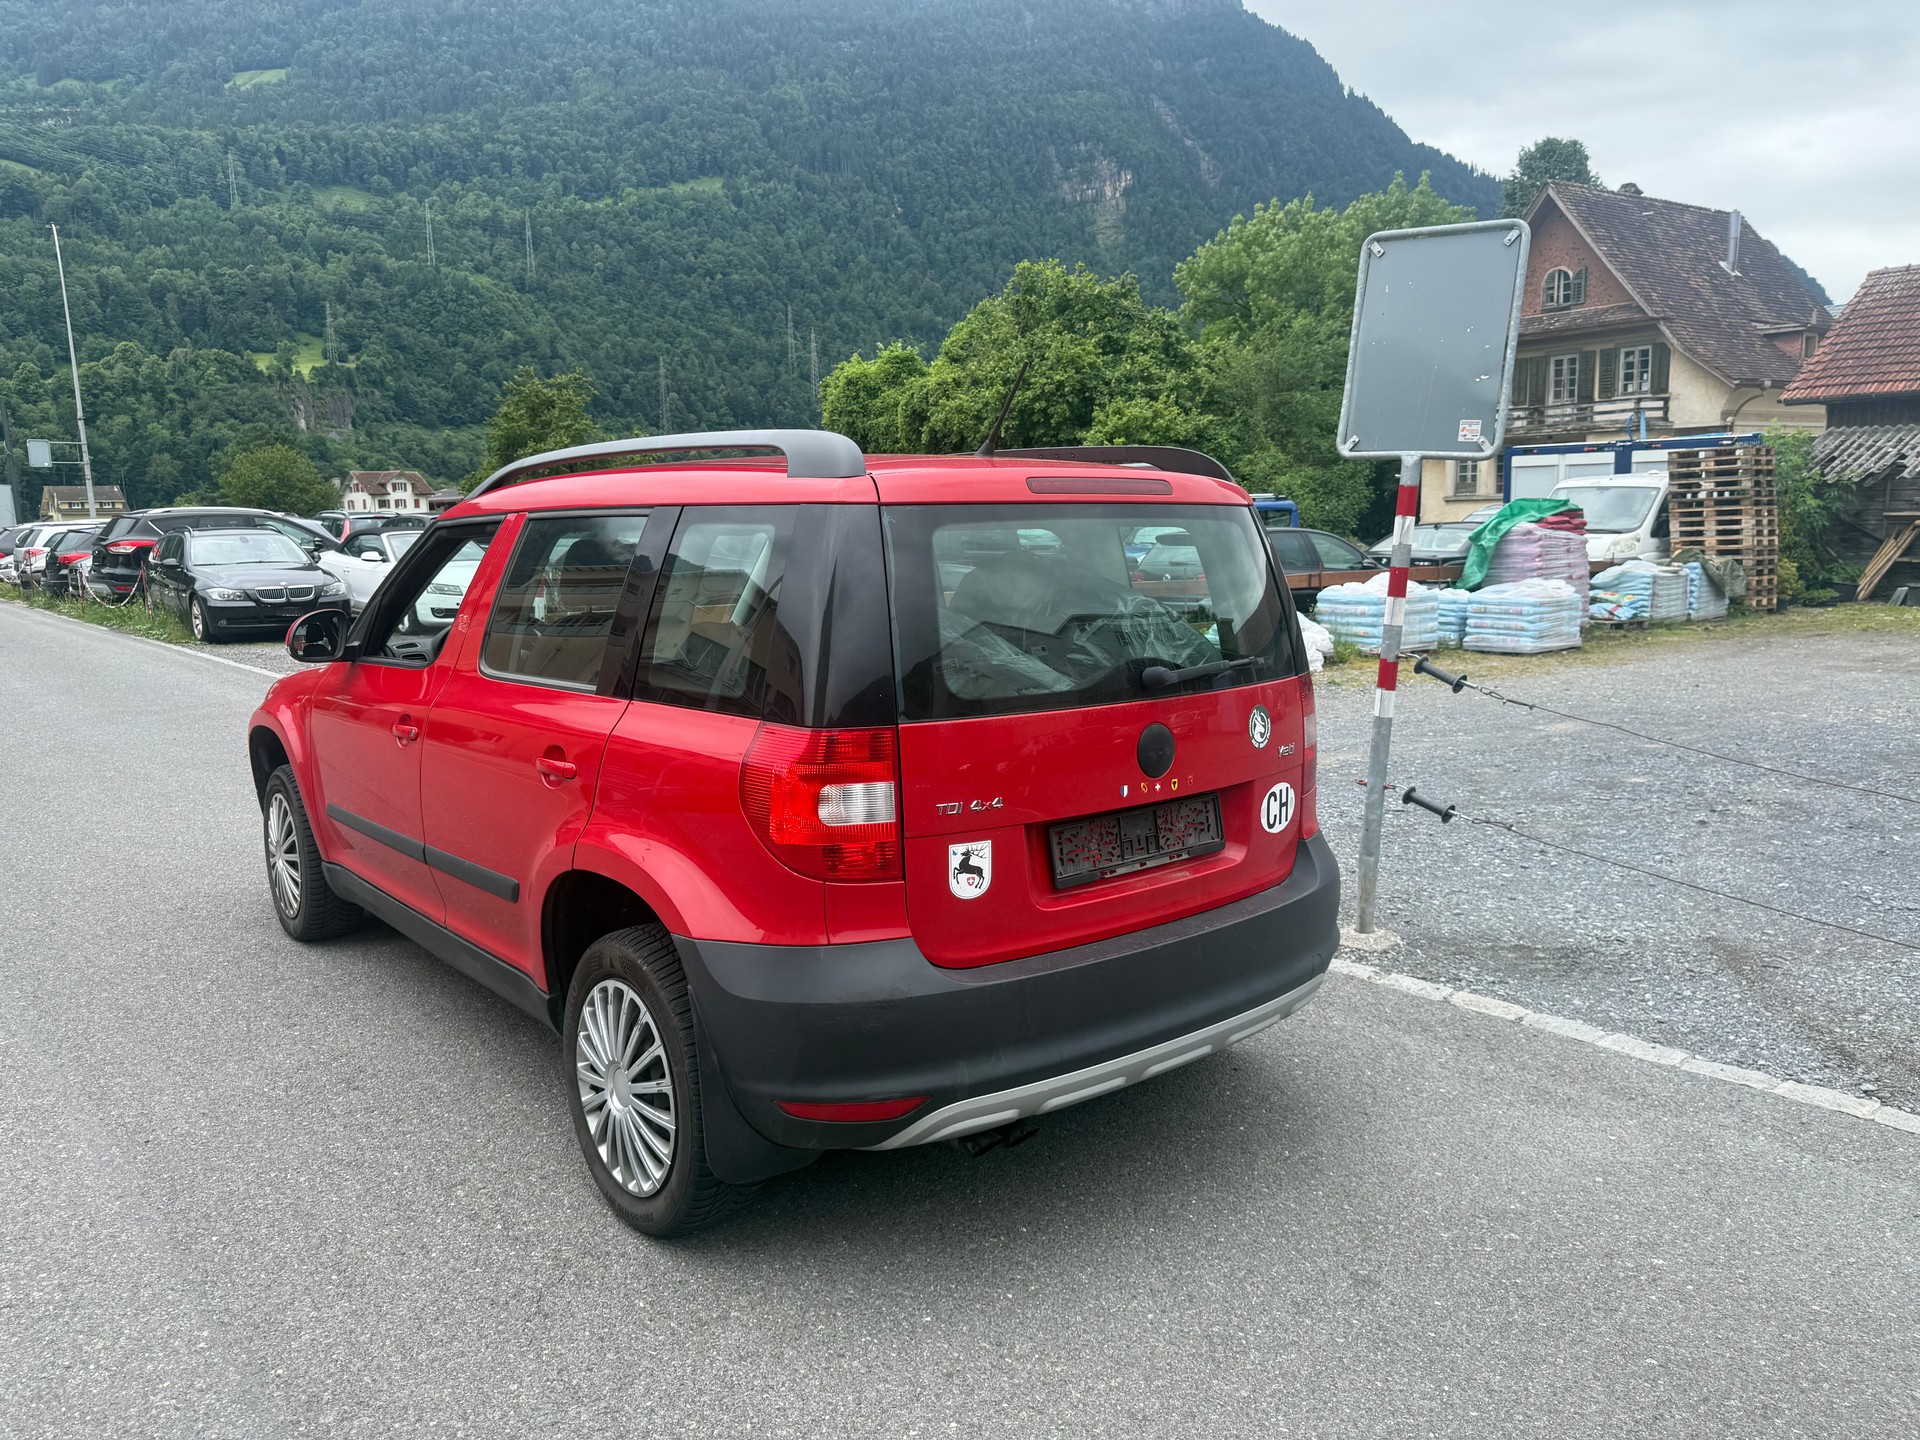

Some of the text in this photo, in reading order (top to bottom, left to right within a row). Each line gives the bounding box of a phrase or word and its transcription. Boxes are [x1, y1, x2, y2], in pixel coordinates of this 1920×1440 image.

[935, 796, 1004, 816] TDI 4x4
[1266, 786, 1289, 830] CH
